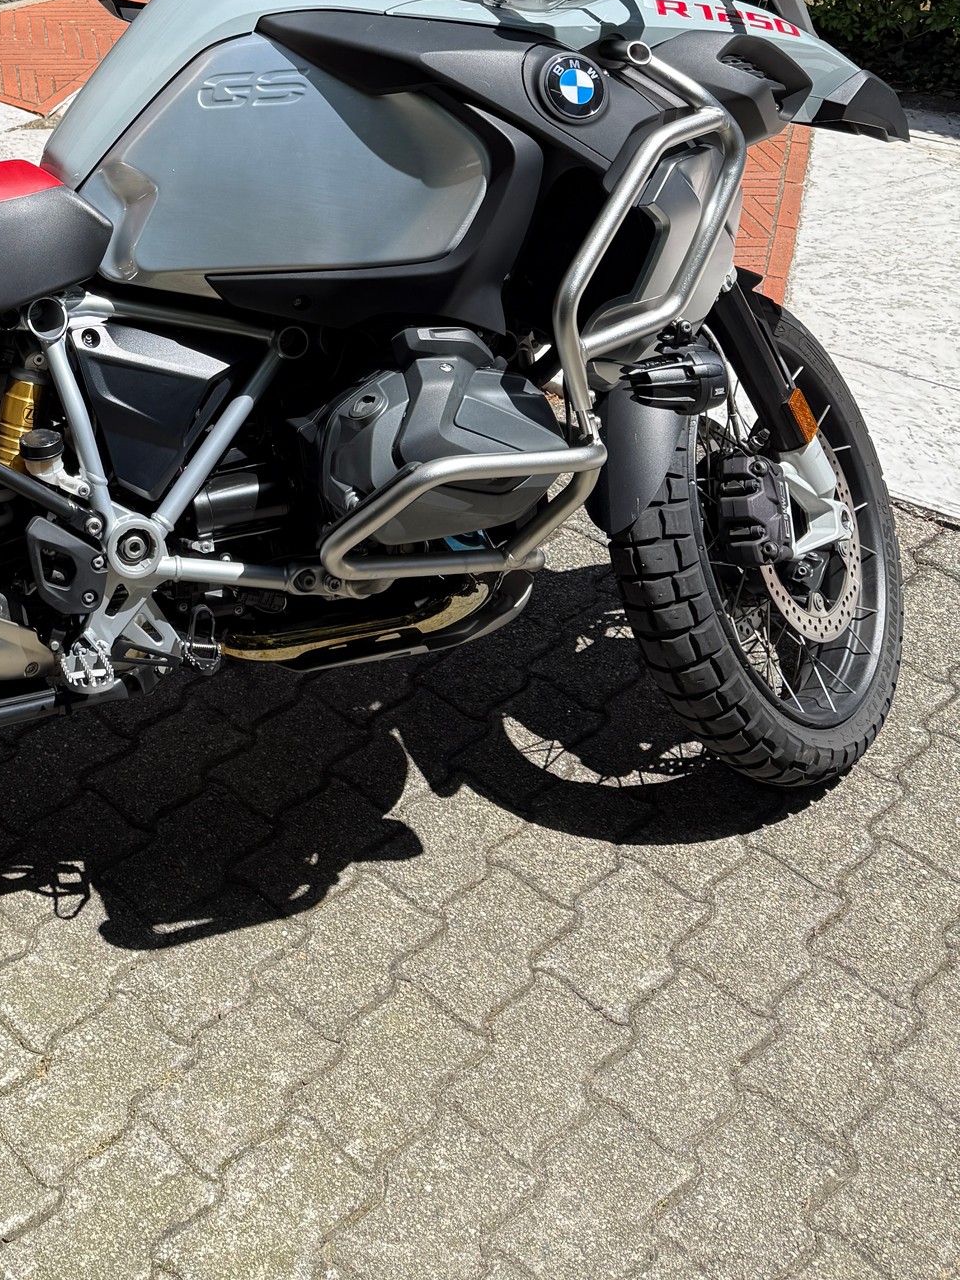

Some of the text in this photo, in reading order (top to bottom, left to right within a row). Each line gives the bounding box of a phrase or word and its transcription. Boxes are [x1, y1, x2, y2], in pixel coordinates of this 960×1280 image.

[197, 68, 310, 109] GS
[552, 59, 599, 80] BMW
[881, 522, 899, 660] SCORPION
